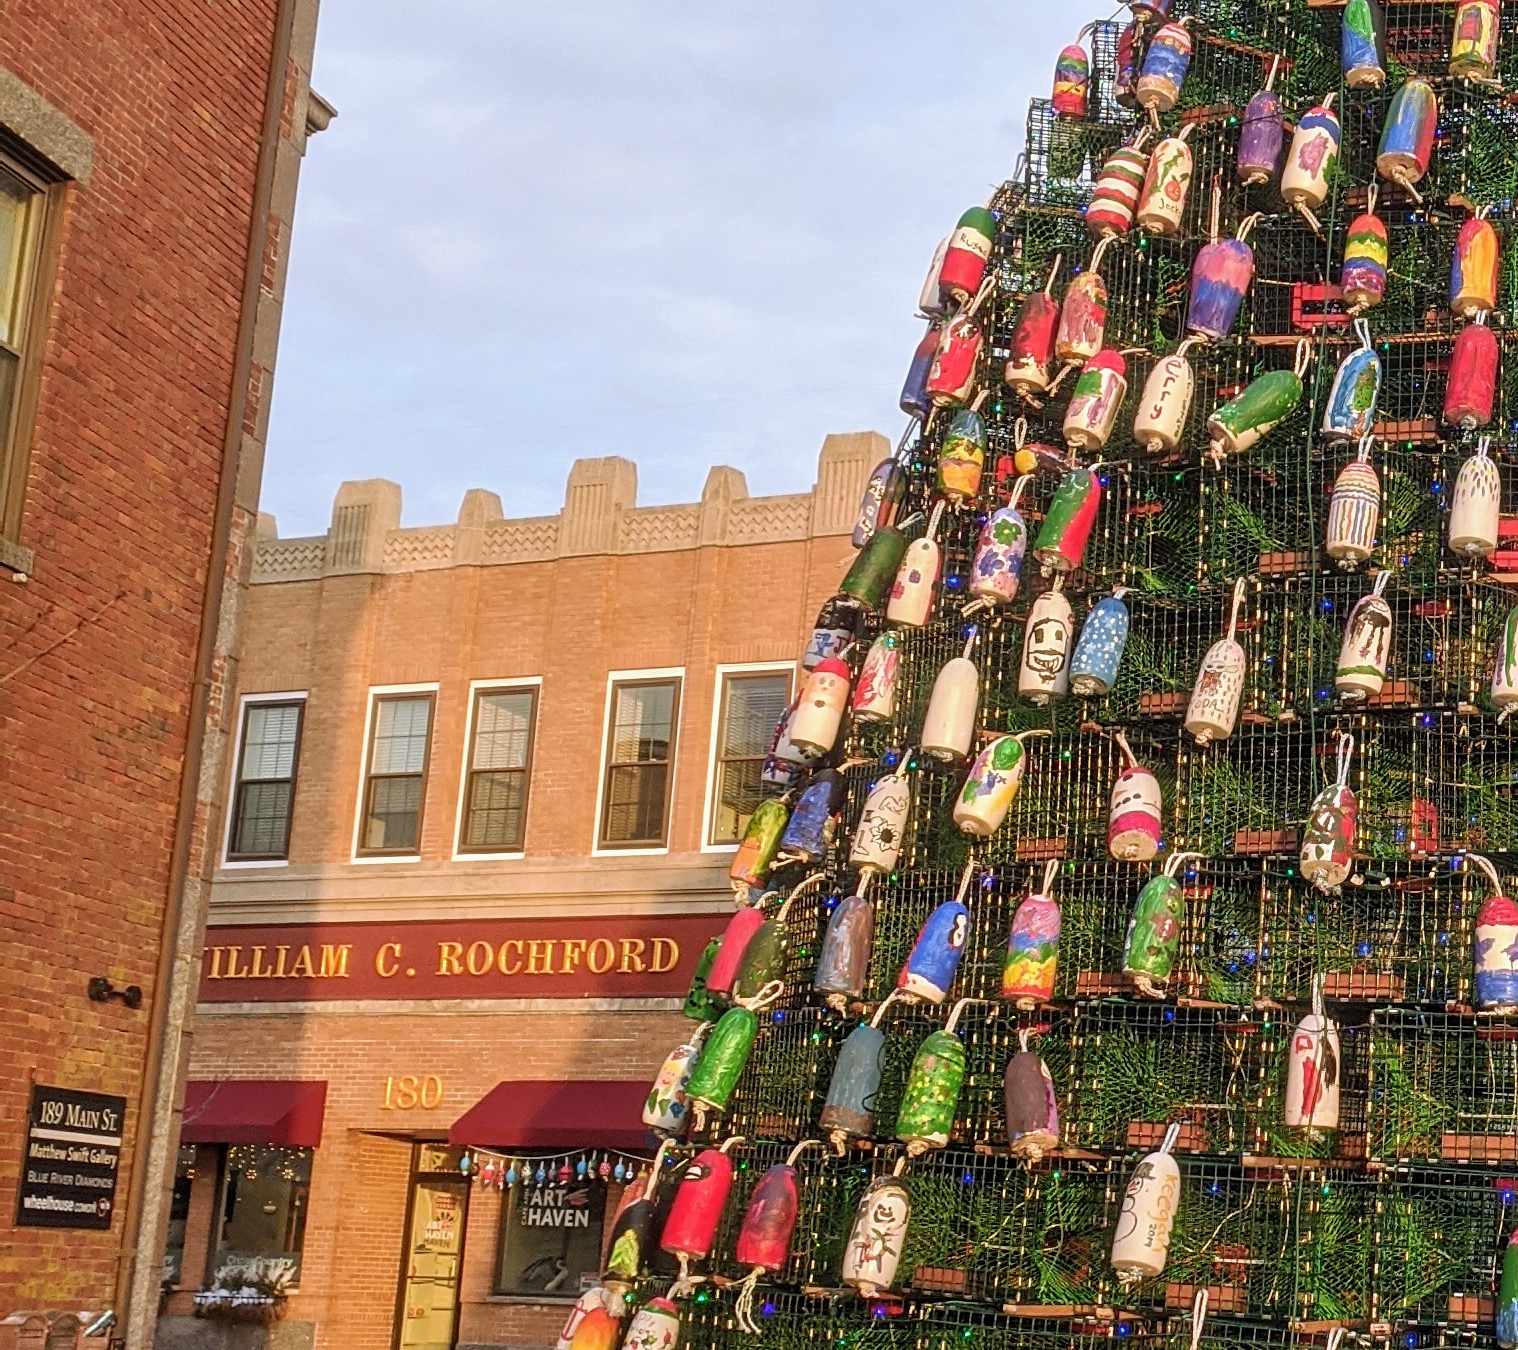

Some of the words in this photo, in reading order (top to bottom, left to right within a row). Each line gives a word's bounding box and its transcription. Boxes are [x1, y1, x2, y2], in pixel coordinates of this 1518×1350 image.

[203, 944, 353, 979] ILLIAM
[435, 937, 680, 976] ROCHFORD
[379, 1074, 443, 1110] 180
[40, 1100, 65, 1125] 189
[29, 1142, 67, 1160] Matthew
[66, 1147, 90, 1164] Swift
[90, 1148, 118, 1169] Gallery
[530, 1188, 567, 1207] ART
[527, 1208, 590, 1228] HAVEN
